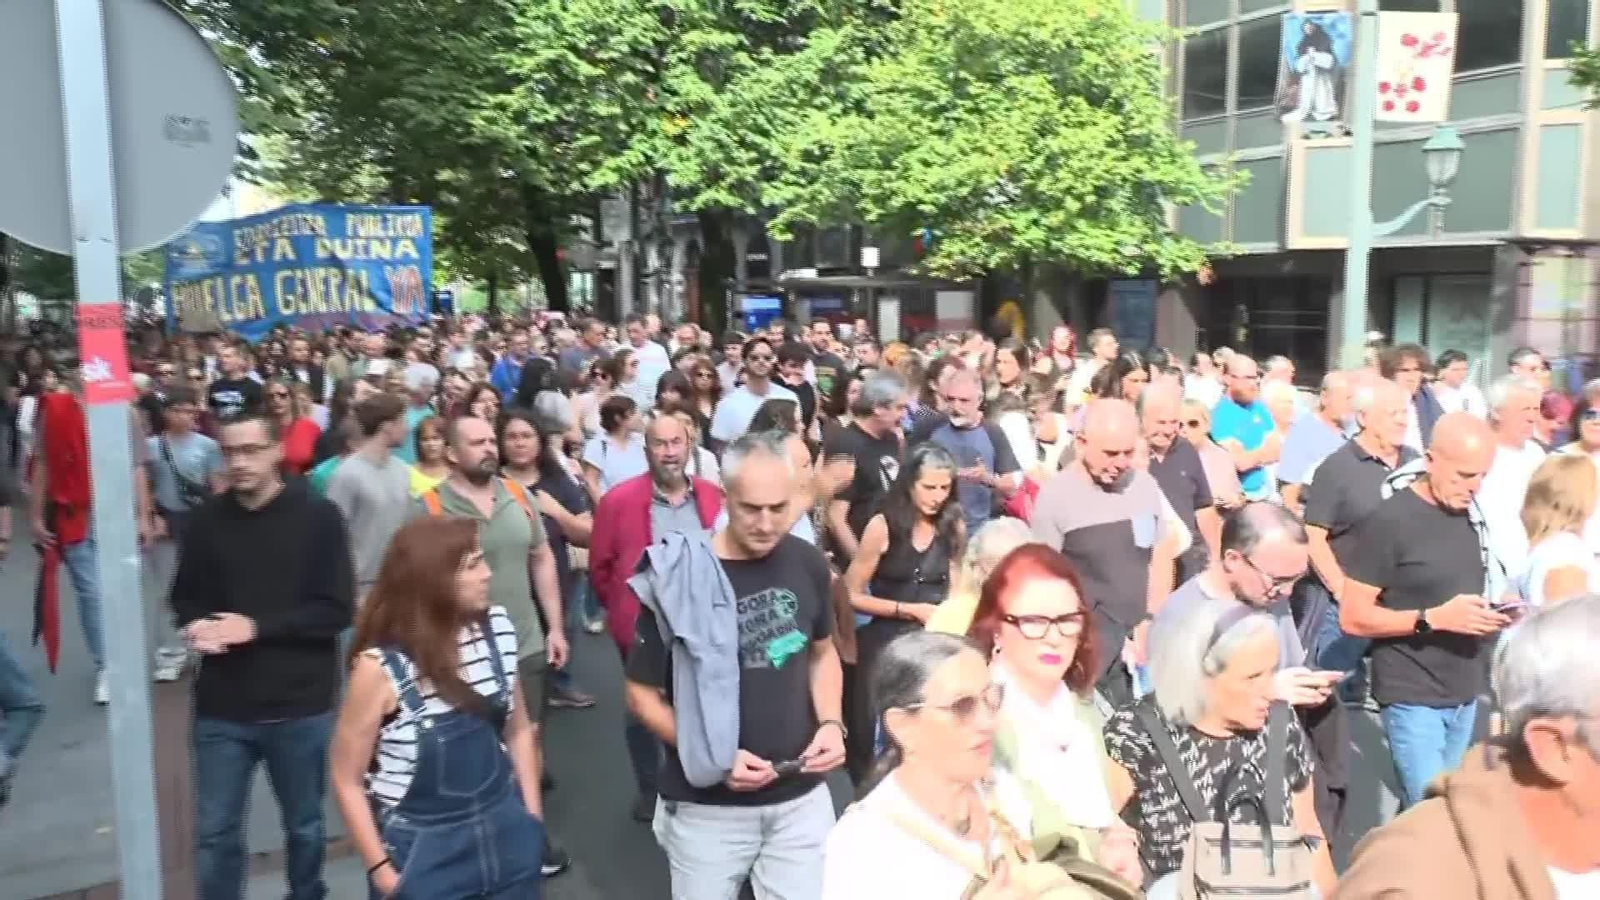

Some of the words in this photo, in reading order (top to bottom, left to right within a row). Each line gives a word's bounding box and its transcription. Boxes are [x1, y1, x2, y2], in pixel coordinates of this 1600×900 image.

[233, 238, 296, 264] ETA
[315, 238, 420, 259] DUINA
[275, 268, 377, 315] GENERAL
[385, 265, 426, 315] YA
